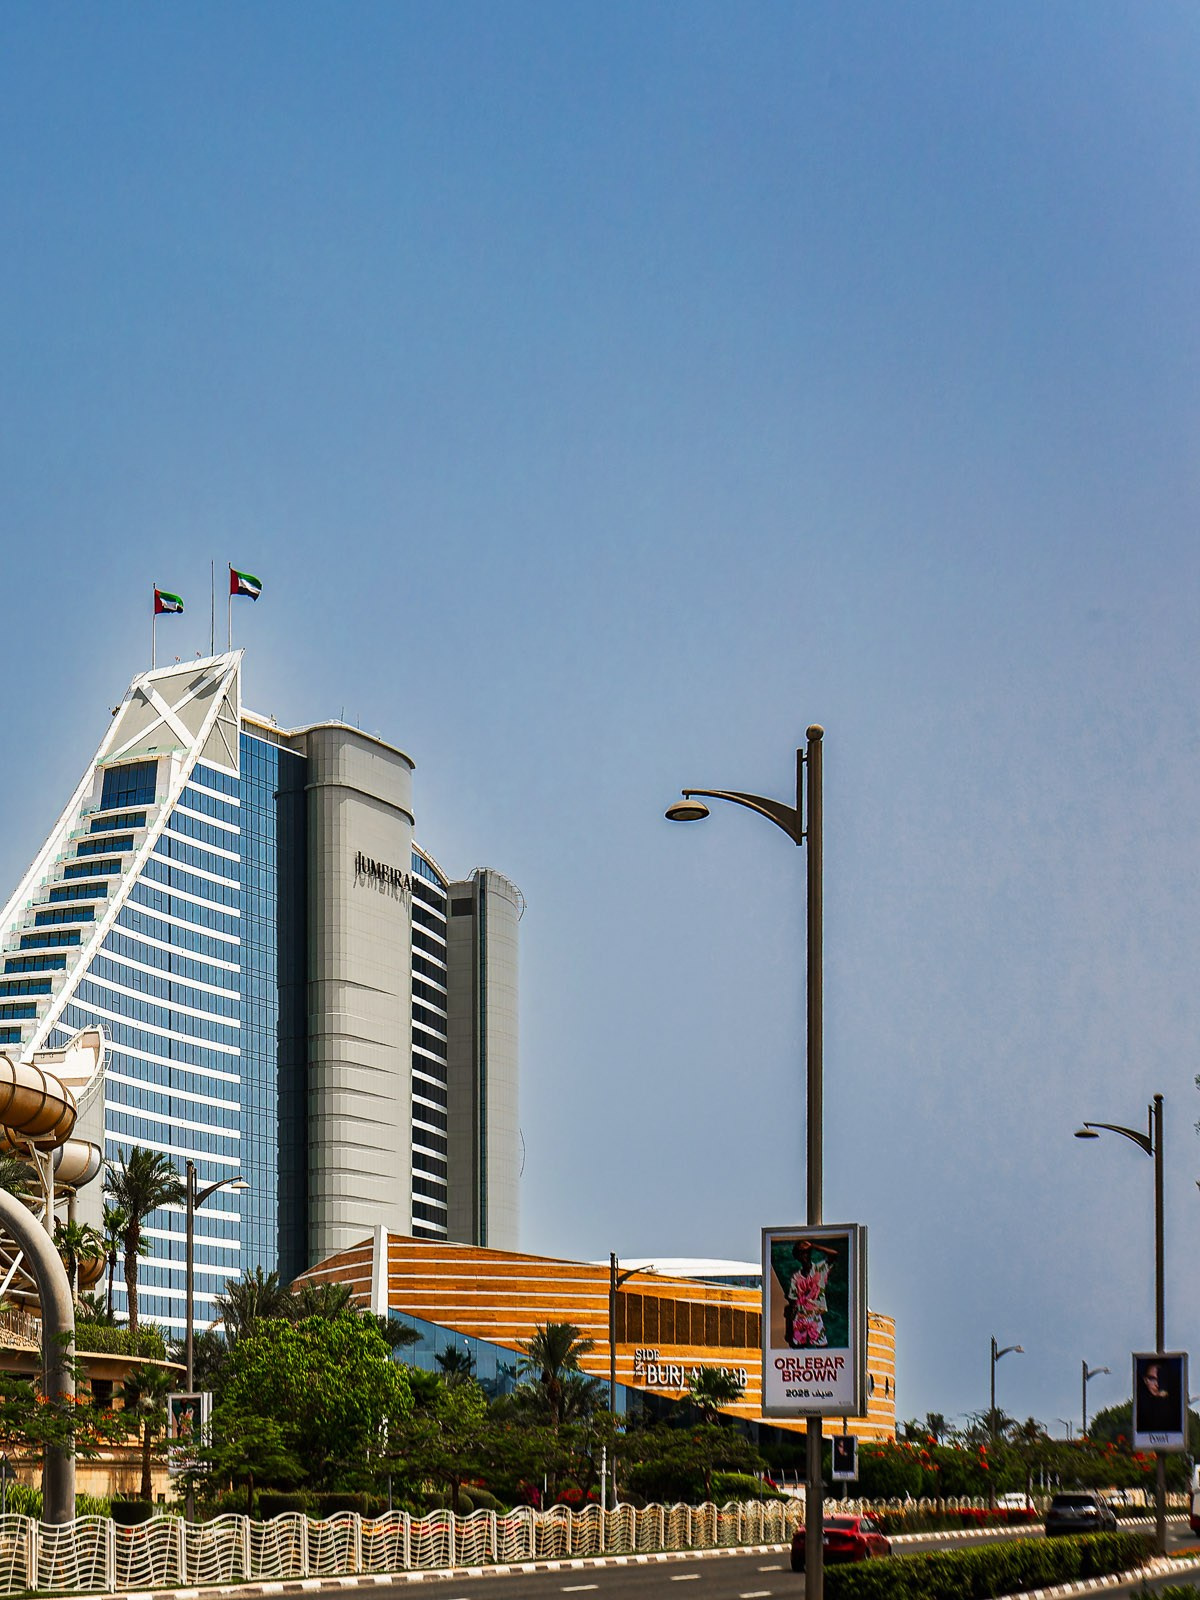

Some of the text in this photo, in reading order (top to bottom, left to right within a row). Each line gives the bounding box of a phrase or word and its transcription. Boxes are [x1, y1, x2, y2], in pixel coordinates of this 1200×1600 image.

[774, 1357, 844, 1370] ORLEBAR
[647, 1364, 685, 1389] BURJ
[782, 1370, 837, 1382] BROWN
